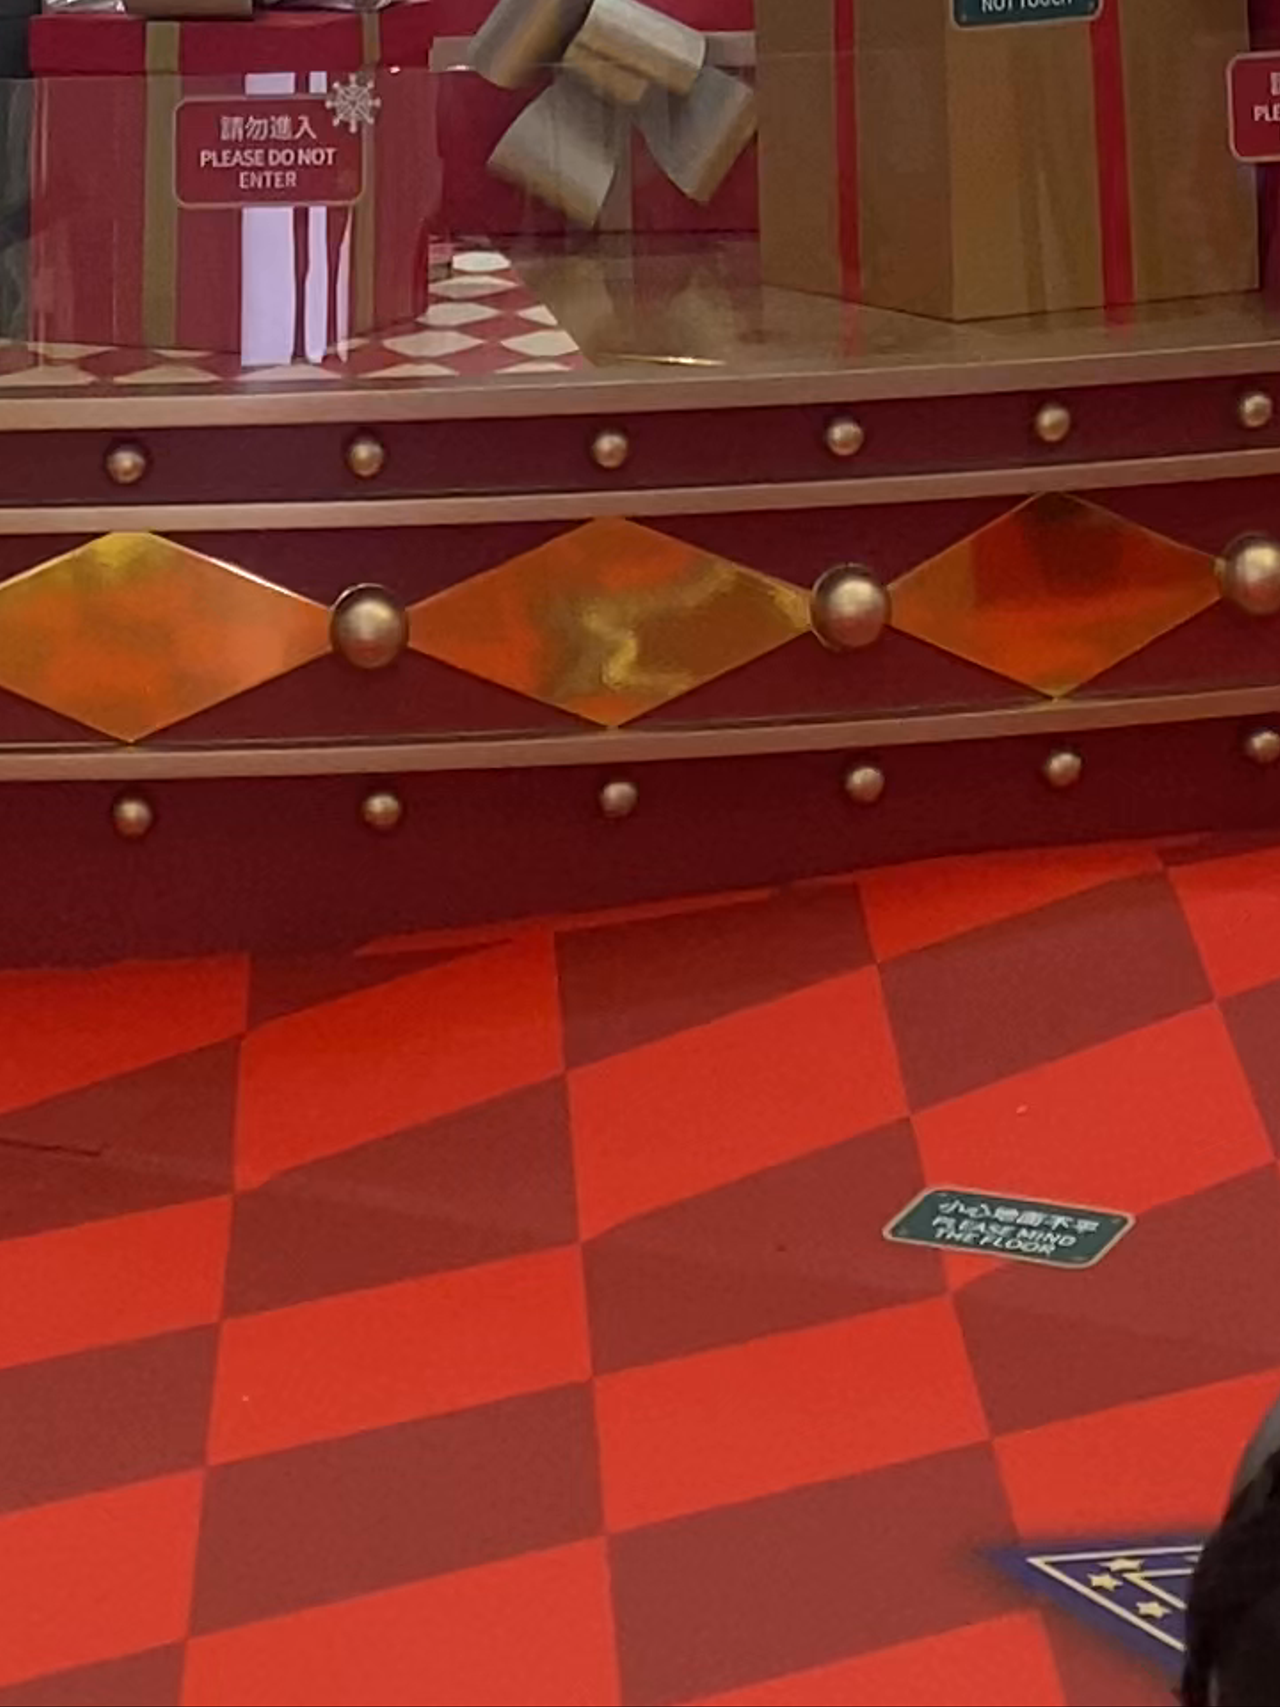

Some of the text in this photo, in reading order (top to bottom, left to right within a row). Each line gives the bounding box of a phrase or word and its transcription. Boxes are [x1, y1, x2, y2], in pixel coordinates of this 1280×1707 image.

[220, 115, 317, 142] 請勿進入
[200, 147, 337, 168] PLEASE DO NOT
[238, 171, 297, 189] ENTER
[938, 1200, 1099, 1233] 小心地面不平
[931, 1216, 1077, 1247] PLEASE MIND
[934, 1227, 1057, 1256] THE FLOOR
